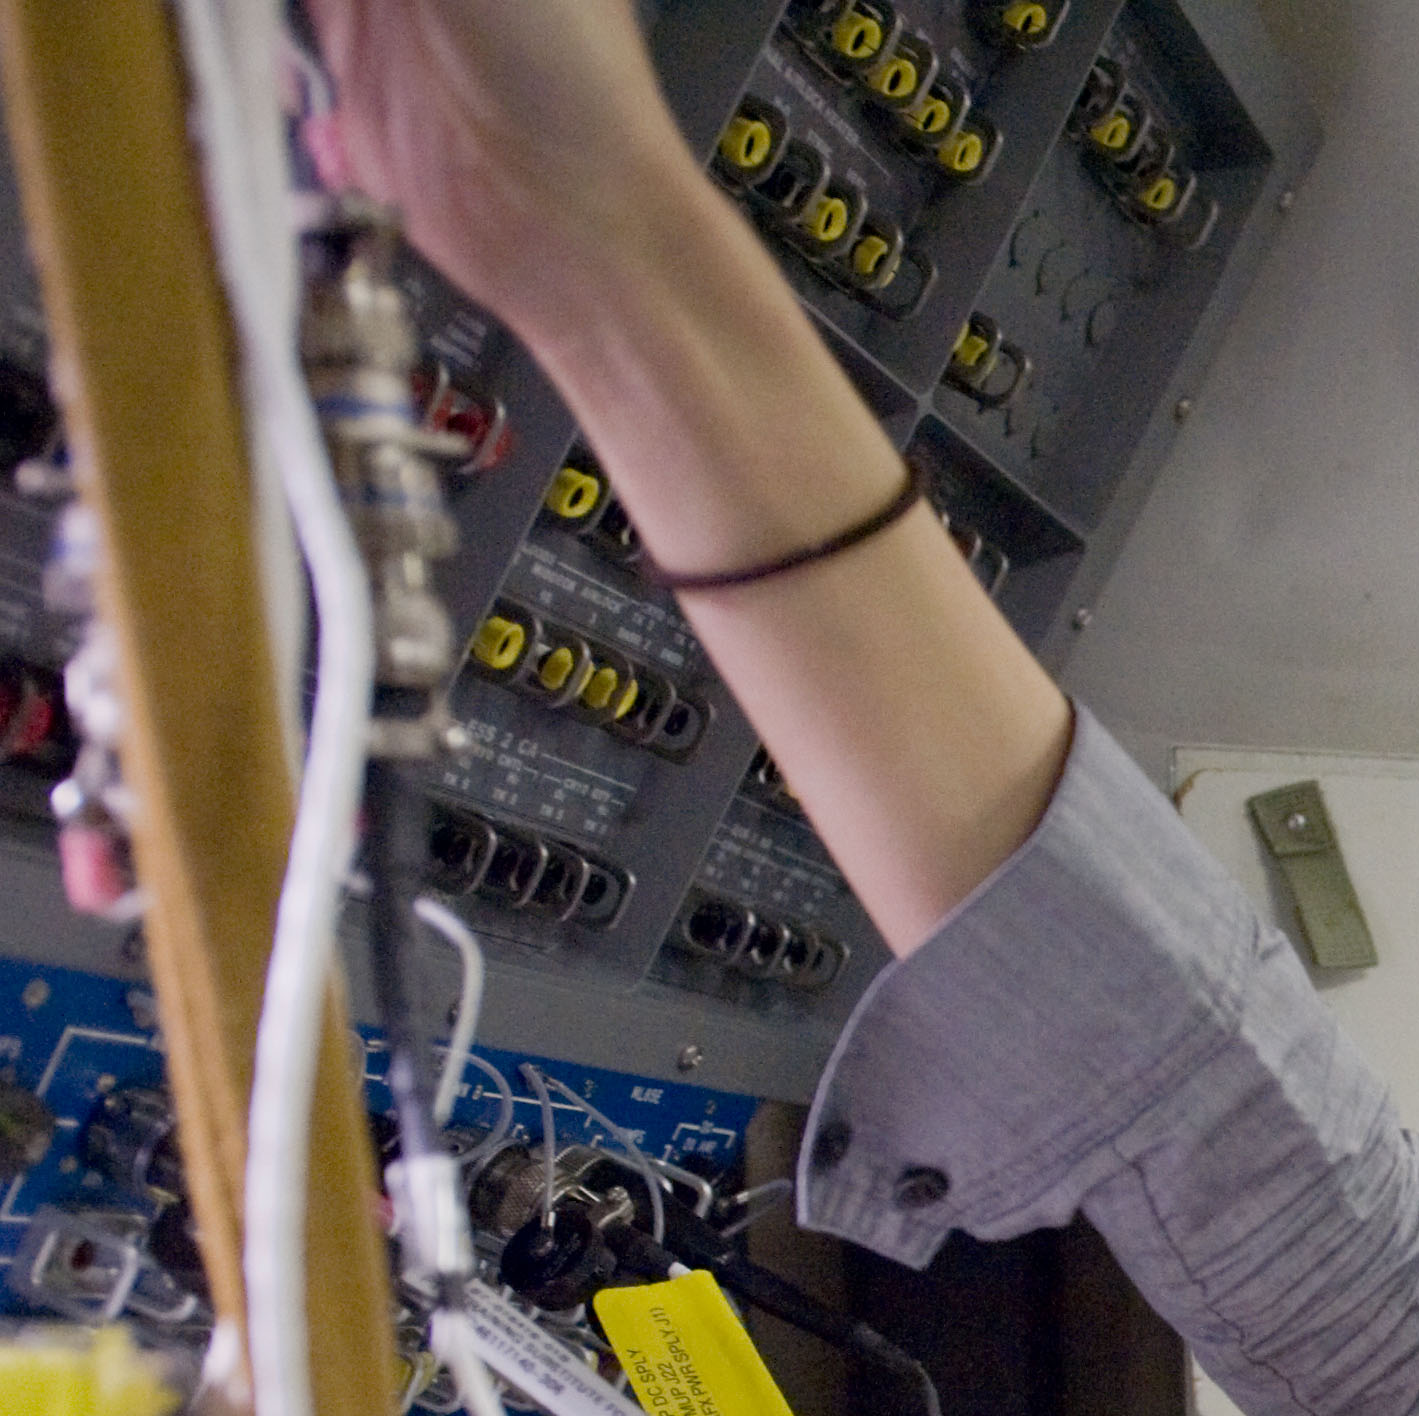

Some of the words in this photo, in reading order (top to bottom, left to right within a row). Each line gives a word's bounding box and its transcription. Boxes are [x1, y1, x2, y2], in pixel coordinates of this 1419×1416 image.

[659, 1328, 690, 1363] SPLY
[626, 1348, 657, 1384] SPLY
[657, 1361, 681, 1385] J22
[679, 1366, 708, 1397] PWR
[647, 1386, 667, 1407] DC
